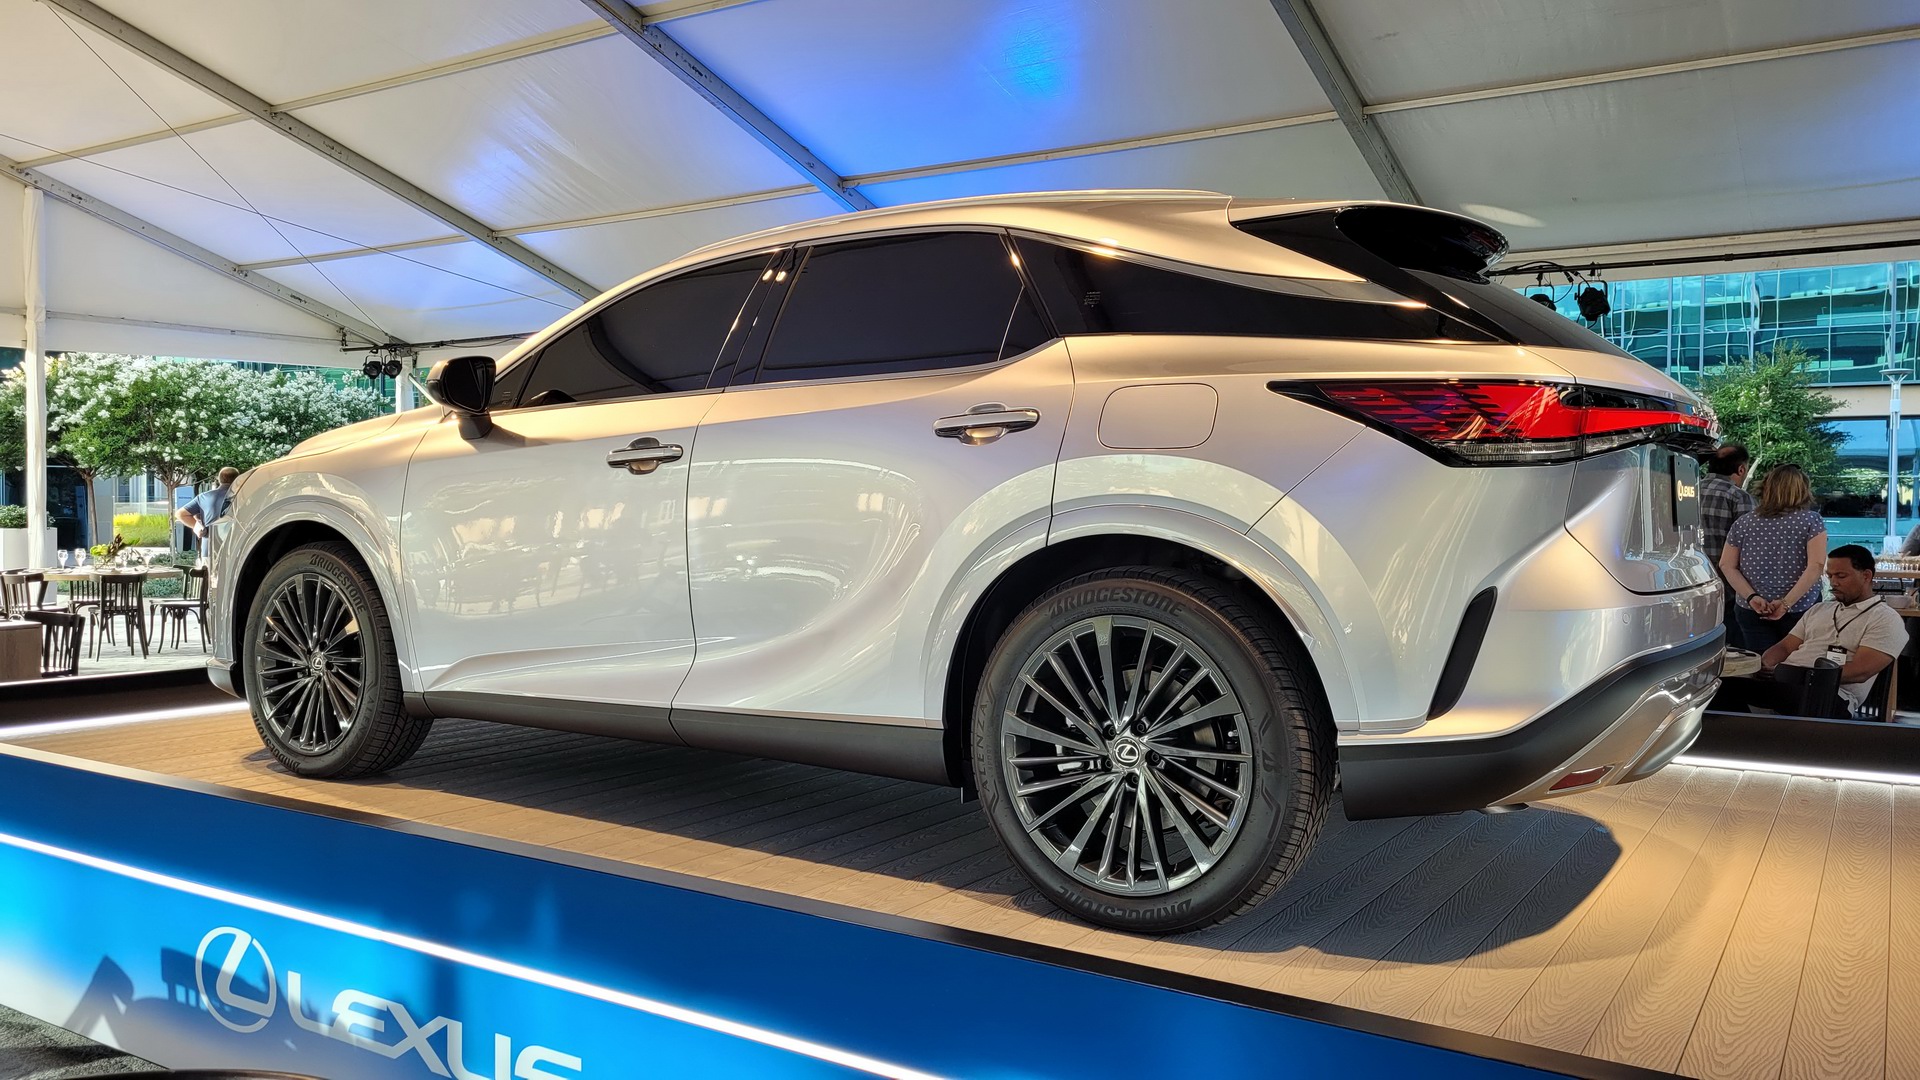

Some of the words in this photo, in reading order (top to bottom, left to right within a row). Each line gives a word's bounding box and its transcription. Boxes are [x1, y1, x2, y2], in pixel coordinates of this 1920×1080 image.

[309, 553, 367, 615] BRIDGESTONE
[1048, 586, 1187, 620] BRIDGESTONE
[976, 703, 990, 792] ALENZA
[1056, 885, 1193, 920] BRIDGESTONE
